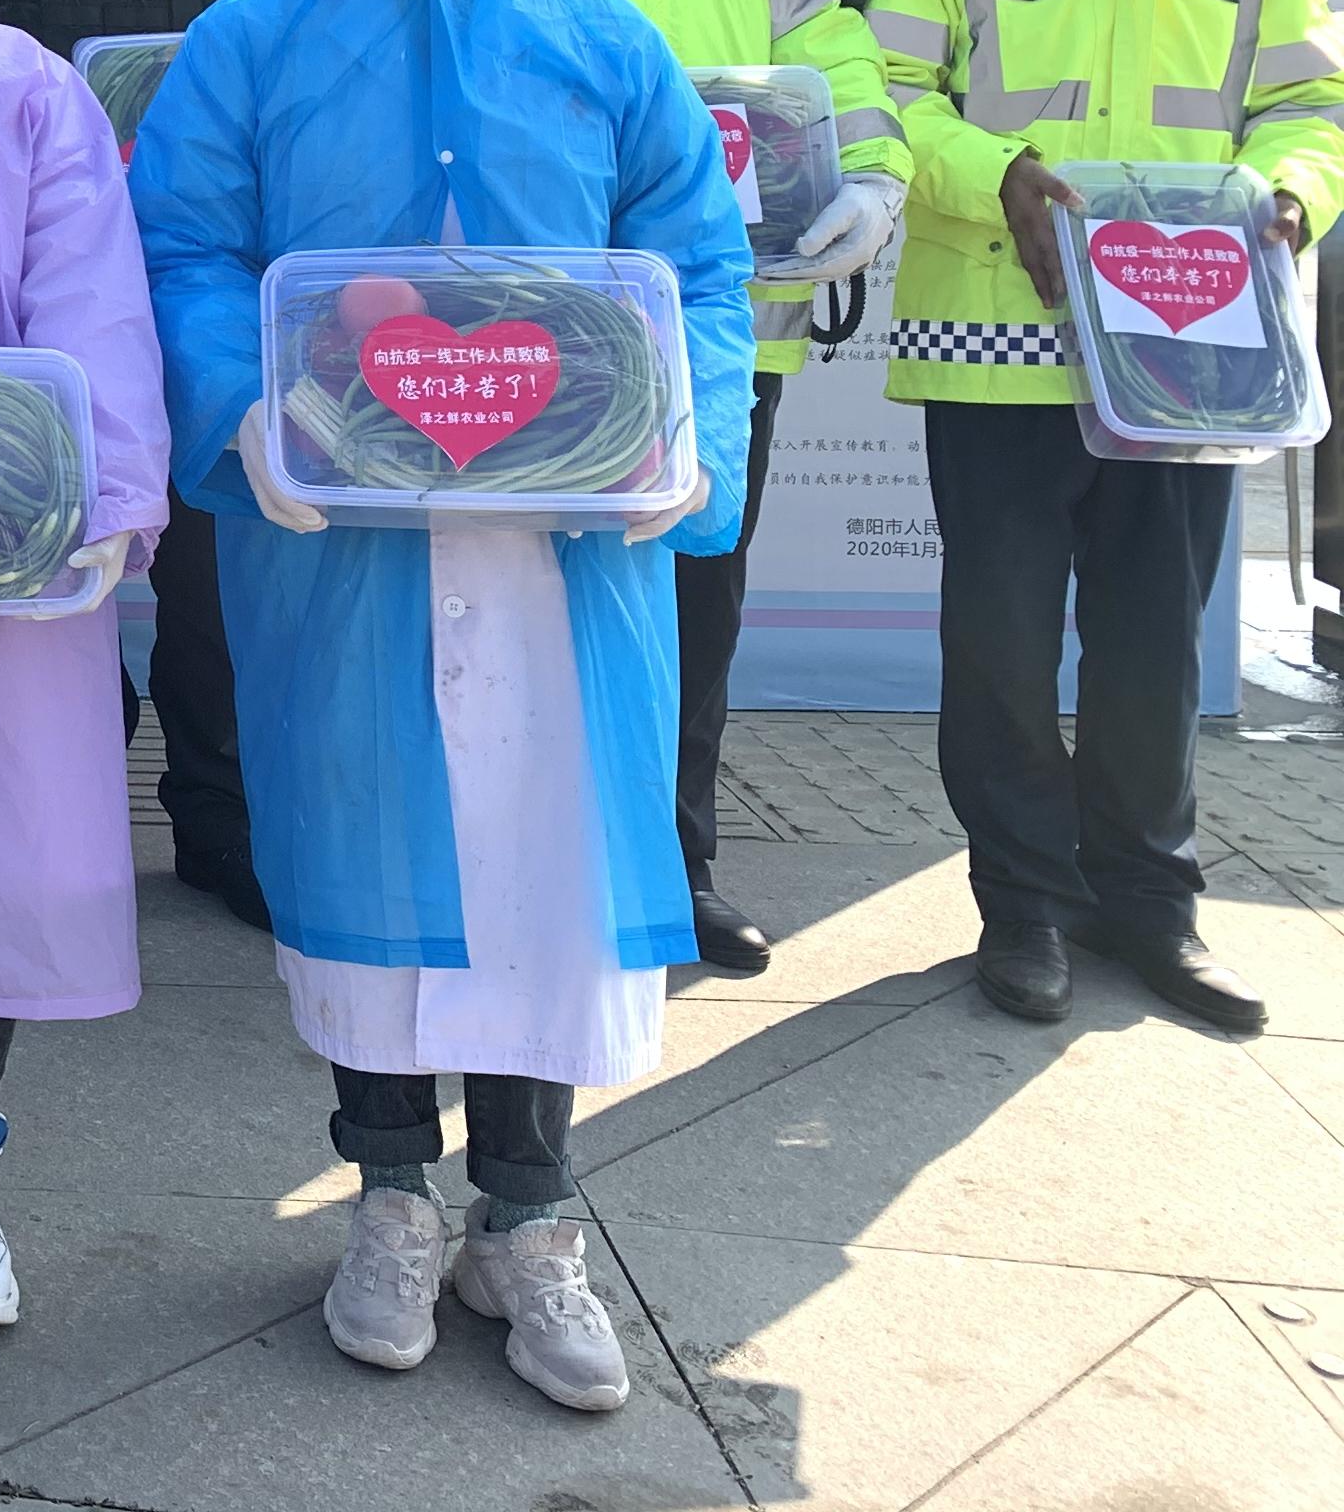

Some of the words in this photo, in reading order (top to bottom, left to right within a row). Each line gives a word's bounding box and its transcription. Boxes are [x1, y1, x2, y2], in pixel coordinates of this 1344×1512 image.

[373, 346, 551, 366] 向抗疫一线工作人员致敬
